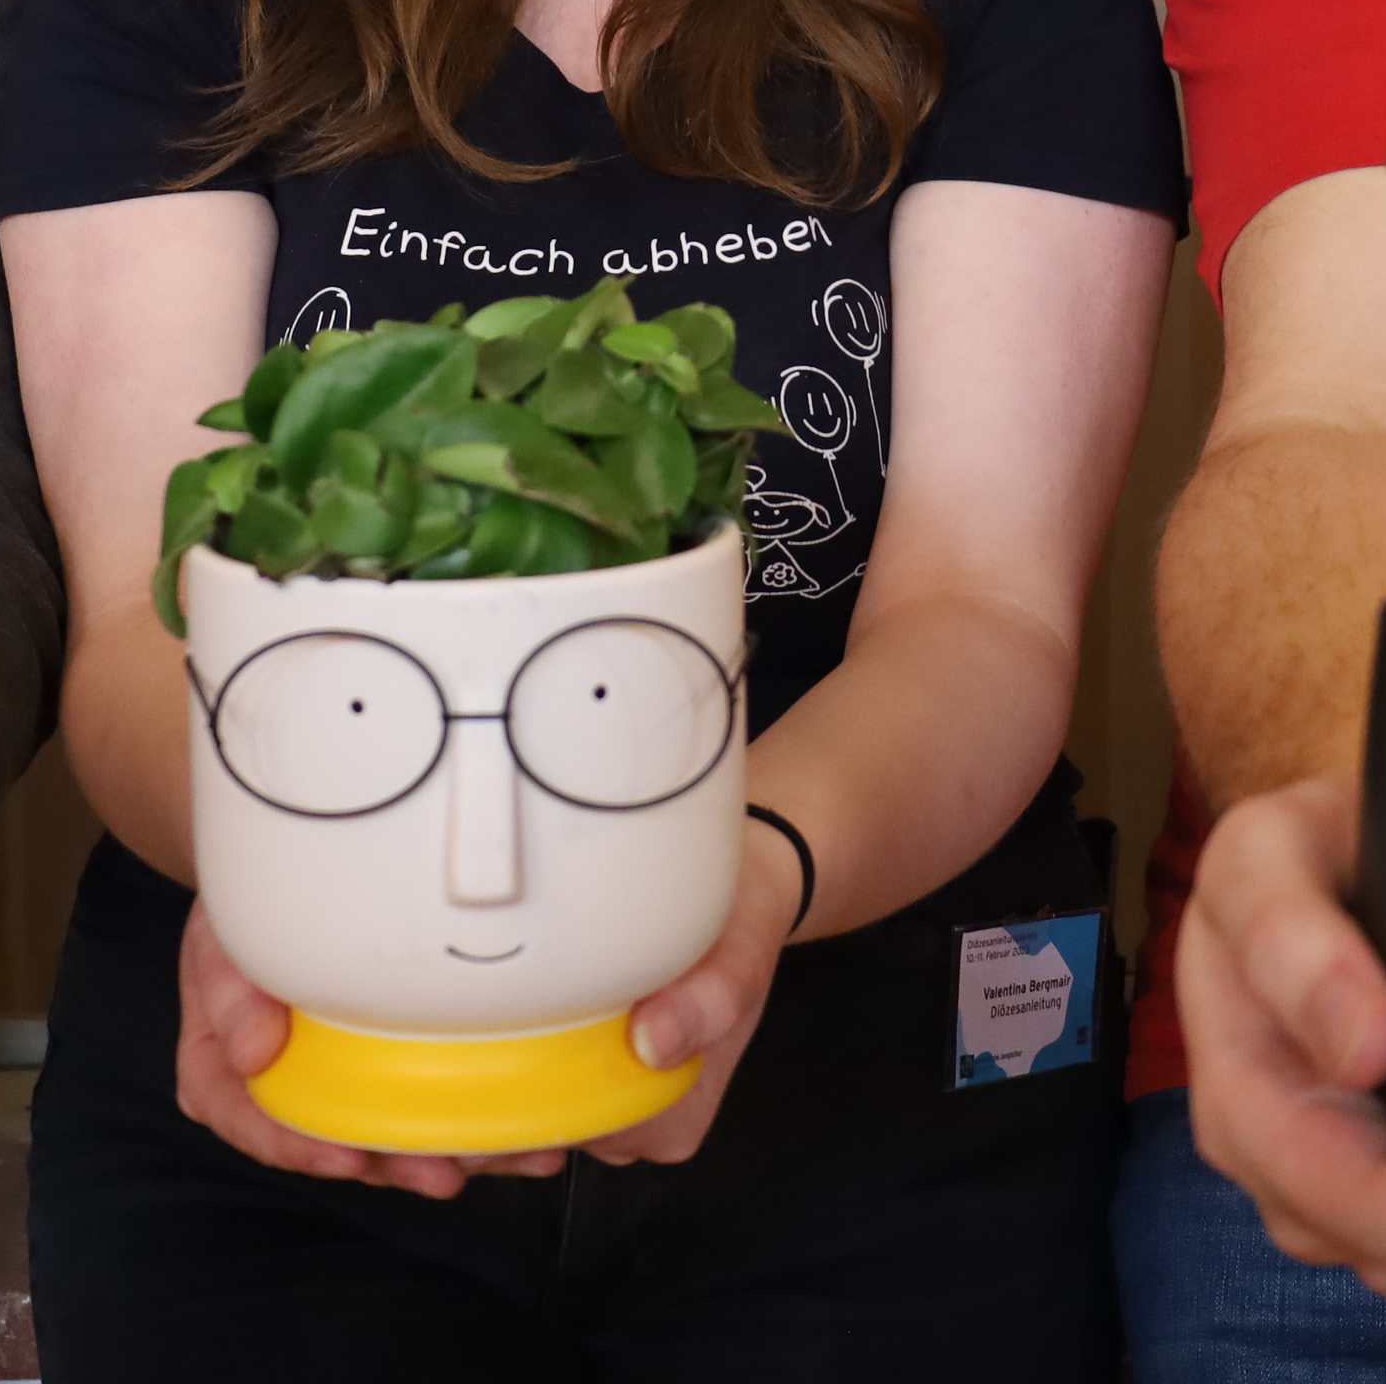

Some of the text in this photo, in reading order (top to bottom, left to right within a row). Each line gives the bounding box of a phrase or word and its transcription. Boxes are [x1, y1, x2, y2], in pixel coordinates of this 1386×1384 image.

[339, 207, 832, 275] Einfach abheben
[985, 948, 1011, 961] Februar
[983, 974, 1072, 1000] Valentina Bergmair
[990, 997, 1062, 1018] Diözesanleitung
